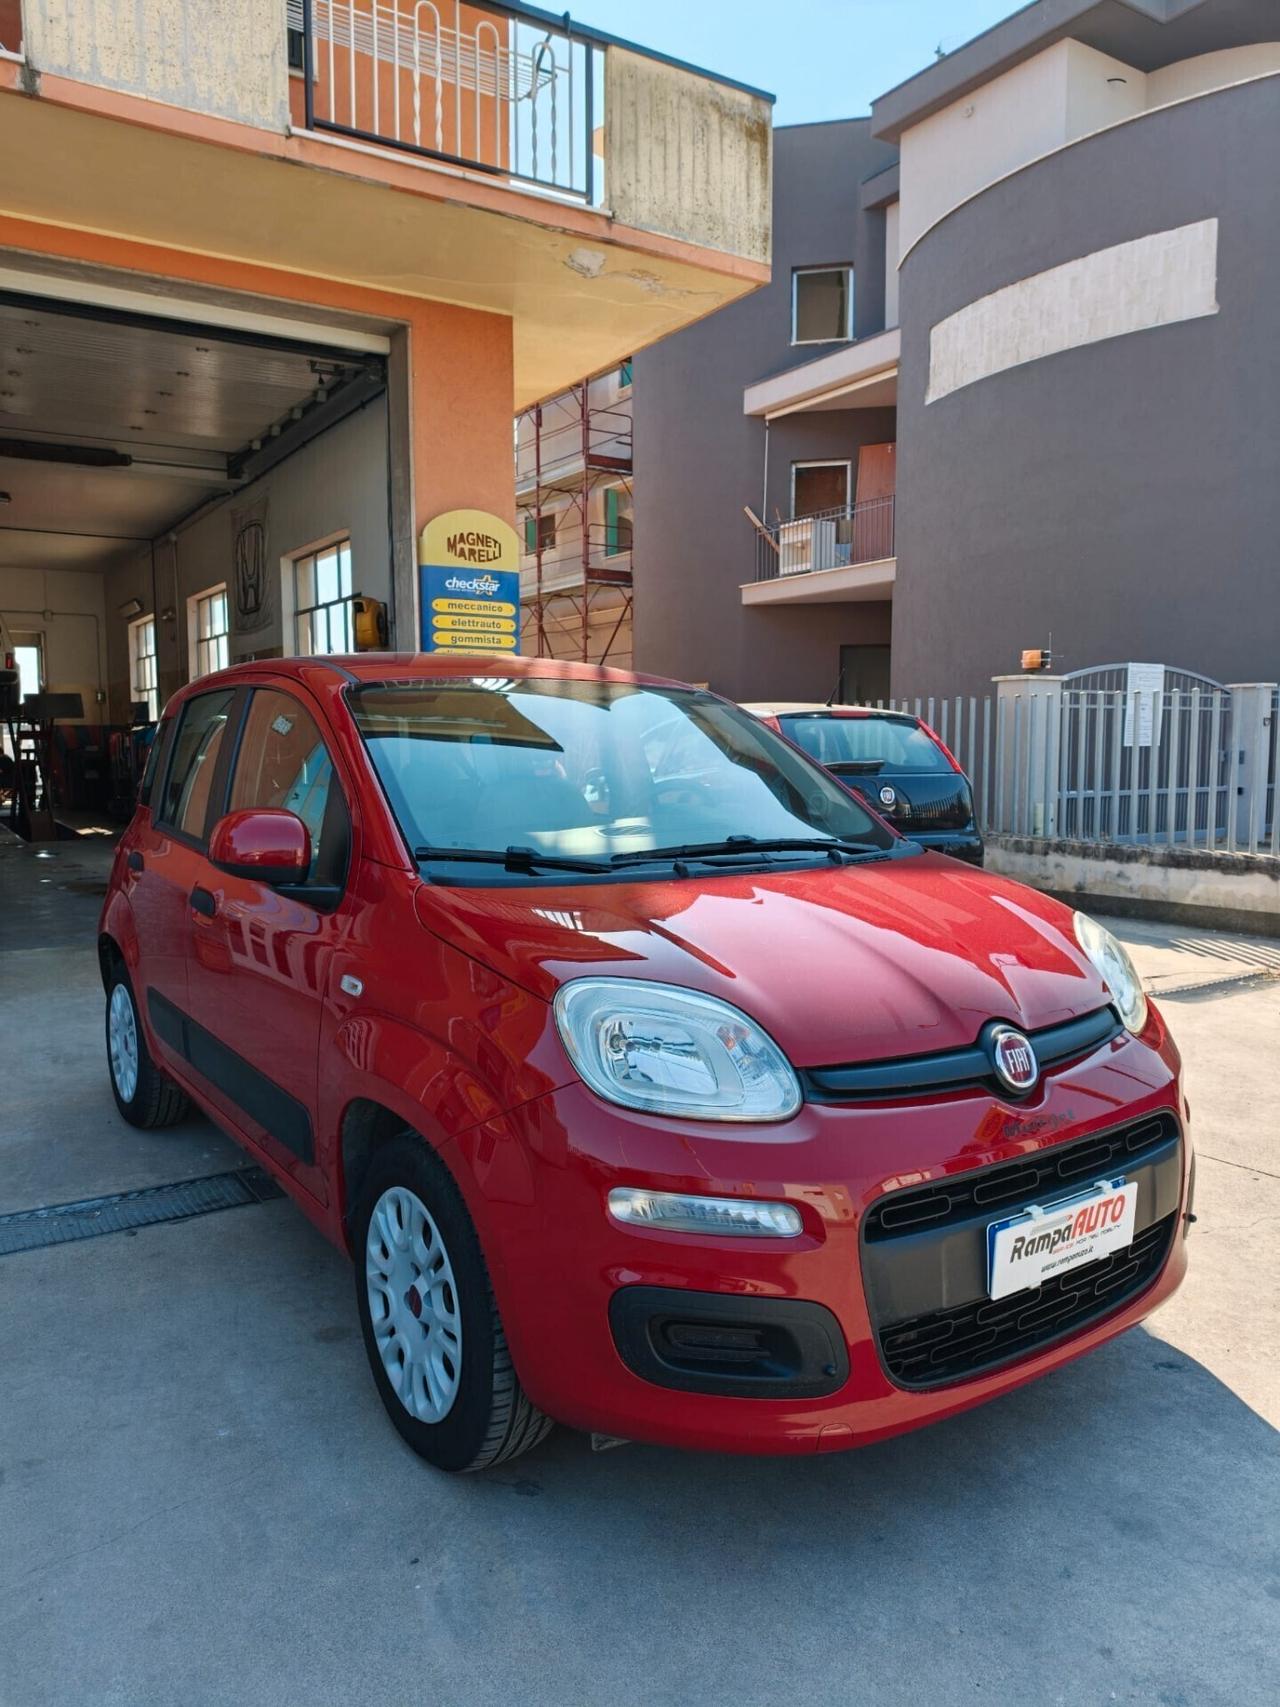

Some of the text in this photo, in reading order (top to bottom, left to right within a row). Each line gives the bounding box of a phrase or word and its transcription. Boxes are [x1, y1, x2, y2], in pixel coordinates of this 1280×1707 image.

[447, 532, 501, 552] MAGNETI
[447, 546, 501, 563] MARELLI
[445, 577, 500, 592] checkstar
[447, 601, 503, 613] meccanico
[451, 617, 502, 629] elettrauto
[450, 633, 502, 645] gommista
[1005, 1047, 1030, 1074] FIAT
